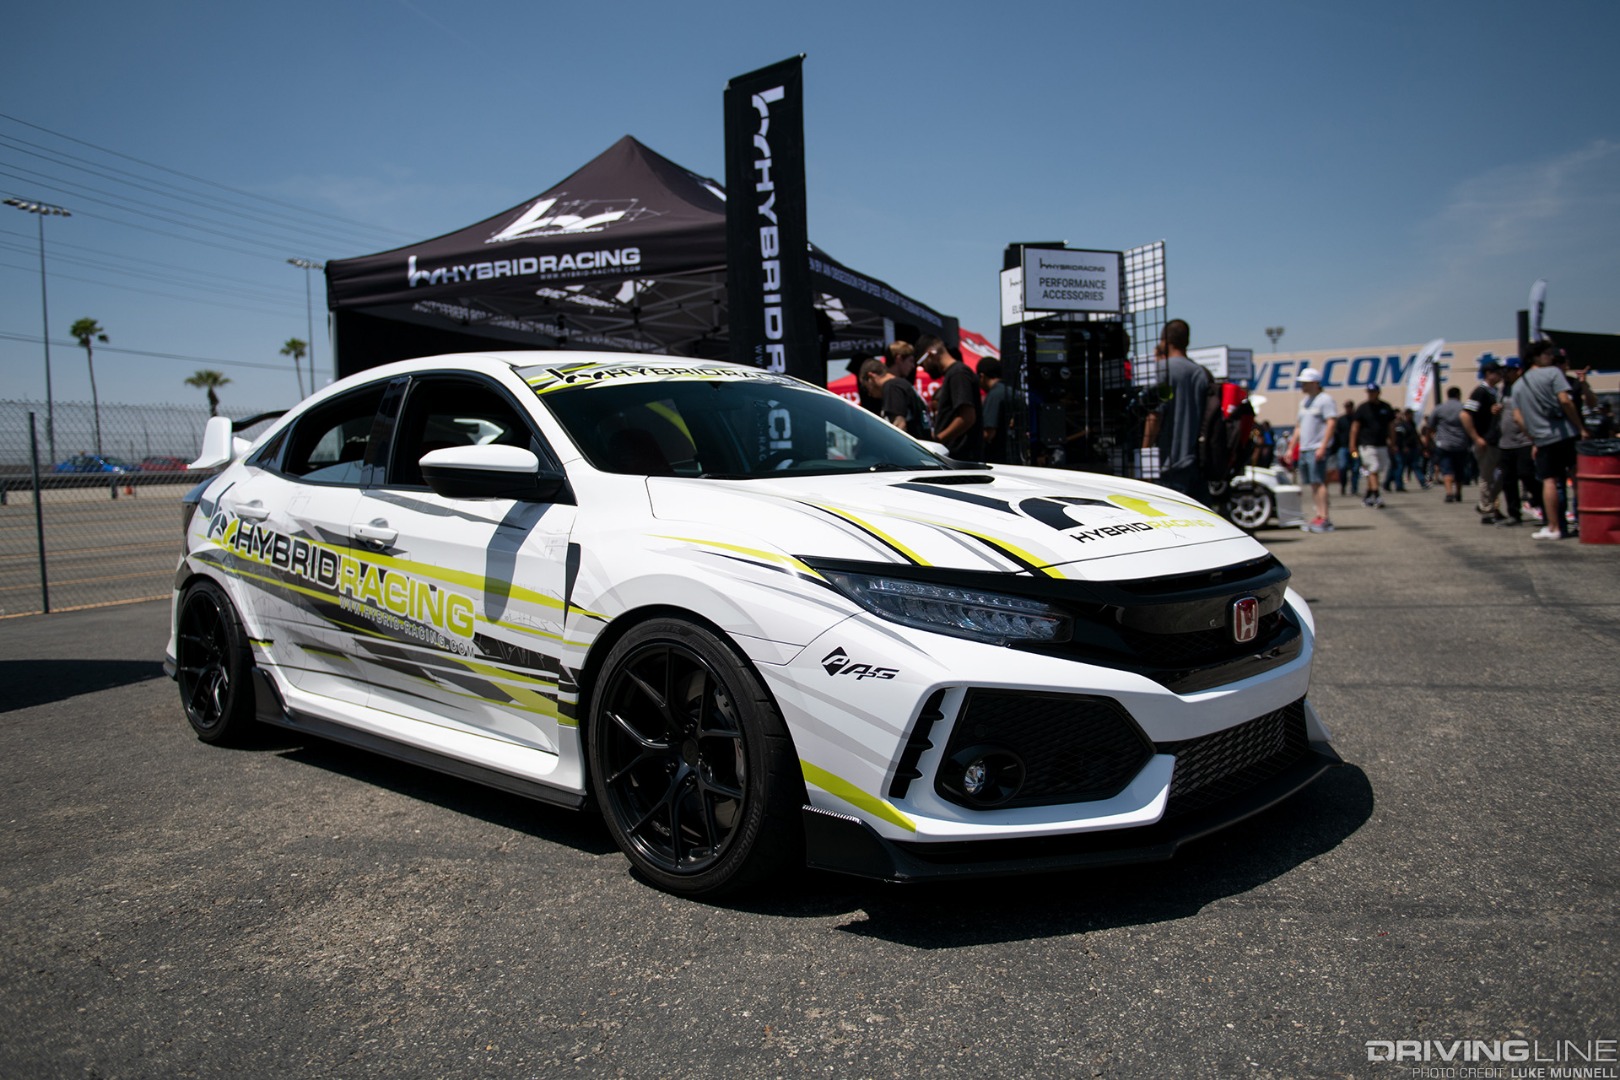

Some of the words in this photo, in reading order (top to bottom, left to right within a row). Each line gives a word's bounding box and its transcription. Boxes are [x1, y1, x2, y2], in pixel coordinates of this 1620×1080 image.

[440, 247, 641, 285] HYBRIDRACING
[1039, 277, 1107, 290] PERFORMANCE
[1042, 289, 1105, 301] ACCESSORIES
[233, 517, 476, 640] HYBRIDRACING
